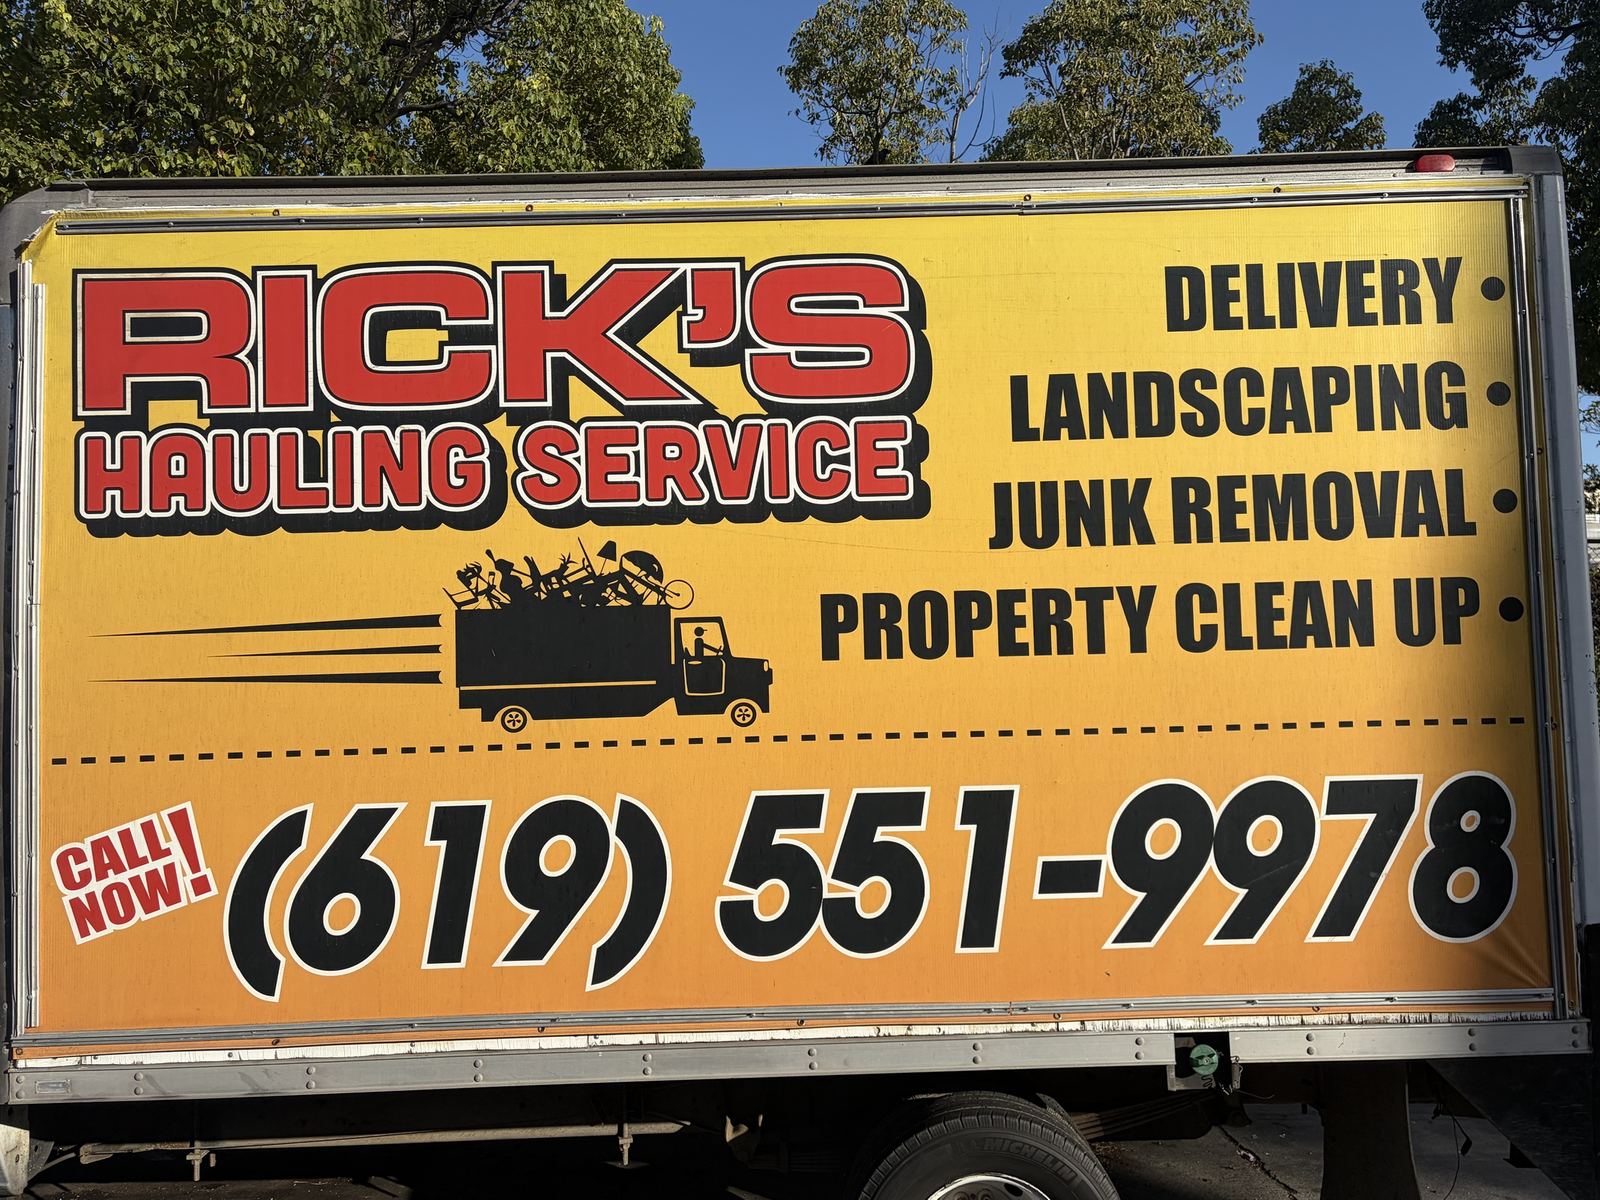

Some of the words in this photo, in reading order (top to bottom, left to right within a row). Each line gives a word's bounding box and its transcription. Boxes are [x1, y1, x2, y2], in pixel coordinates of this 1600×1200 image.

[77, 257, 918, 416] RICK'S
[1165, 257, 1462, 332] DELIVERY
[1010, 360, 1468, 442] LANDSCAPING
[78, 420, 492, 519] HAULING
[514, 415, 915, 511] SERVICE
[989, 477, 1153, 550] JUNK
[1172, 468, 1477, 545] REMOVAL
[820, 585, 1157, 662] PROPERTY
[1175, 578, 1375, 654] CLEAN
[1392, 576, 1480, 648] UP
[223, 793, 672, 1003] (619)
[983, 1136, 1078, 1183] MICHELIN
